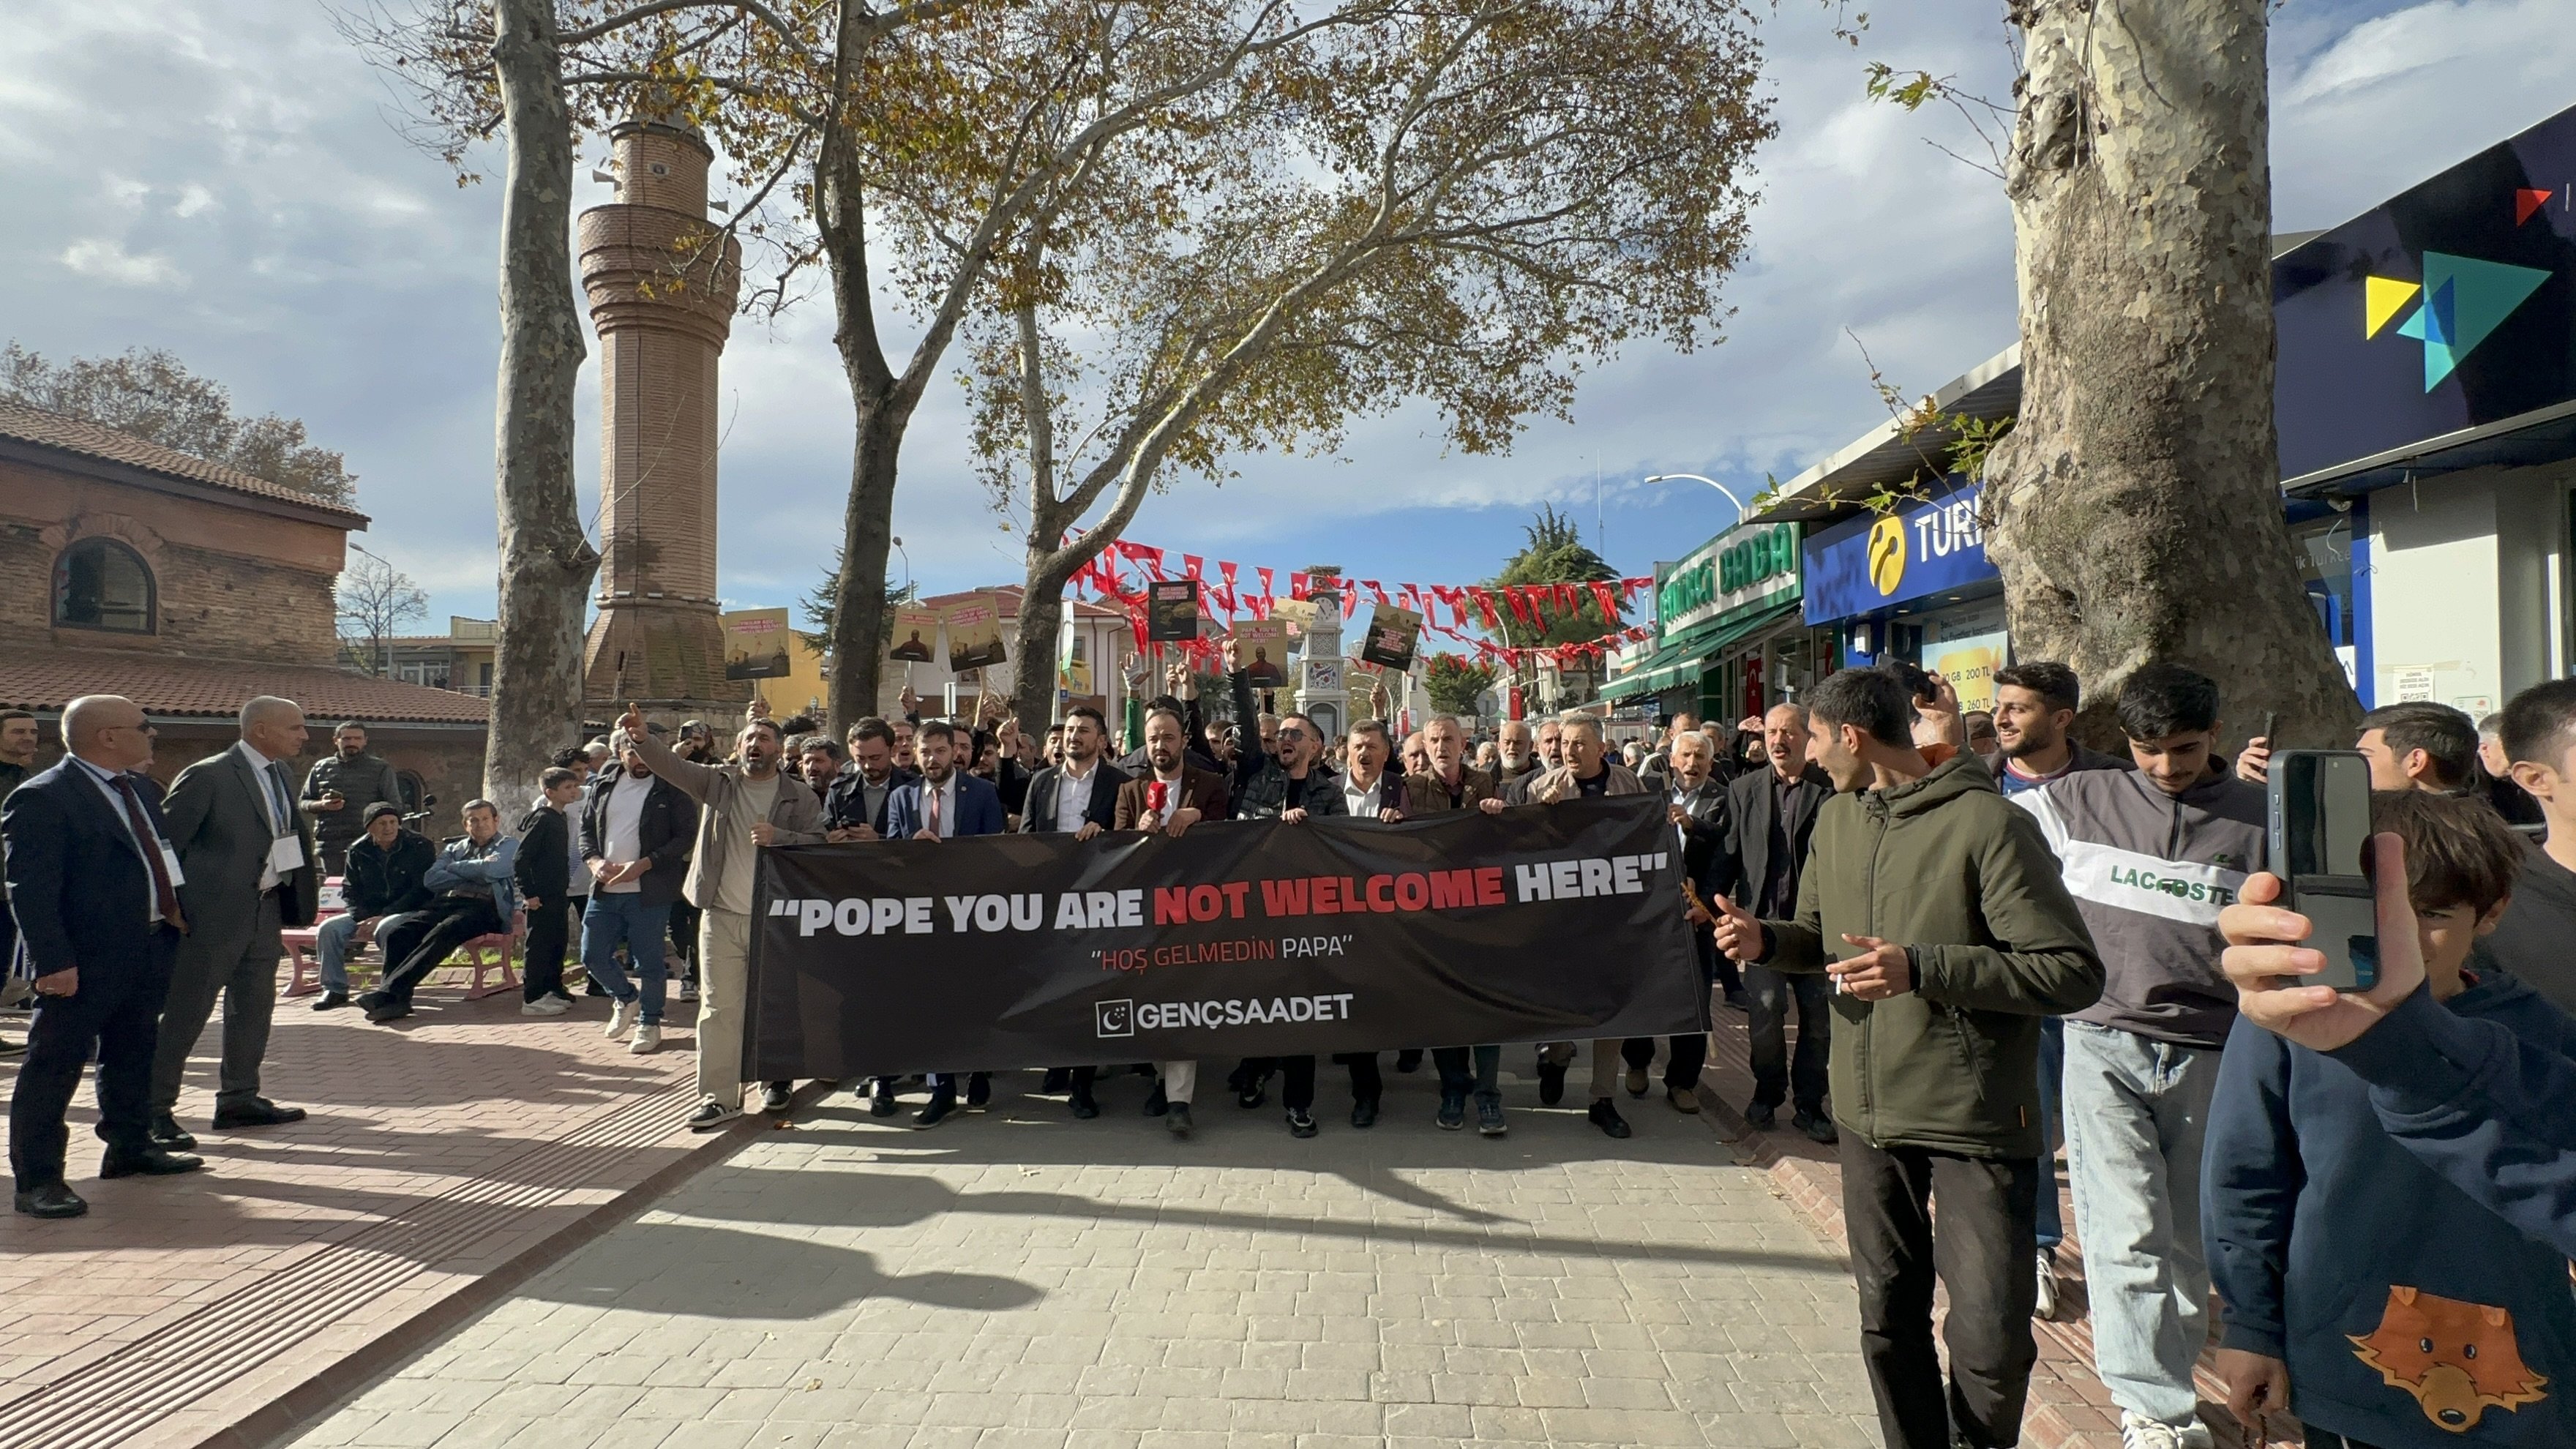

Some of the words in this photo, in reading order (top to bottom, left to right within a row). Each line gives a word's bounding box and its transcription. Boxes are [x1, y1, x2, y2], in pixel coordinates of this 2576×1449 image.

[1720, 522, 1794, 595] BABA
[1951, 671, 1961, 682] GB
[1966, 667, 1980, 680] 200
[1982, 666, 1990, 677] TL
[1967, 699, 1980, 711] 260
[1982, 697, 1990, 708] TL
[944, 894, 1043, 933] YOU
[1054, 888, 1143, 929] ARE
[1154, 882, 1250, 926] NOT
[1260, 866, 1506, 918] WELCOME
[2111, 864, 2234, 907] LACOSTE
[1154, 936, 1274, 966] GELMEDİN
[1137, 993, 1354, 1030] GENÇSAADET
